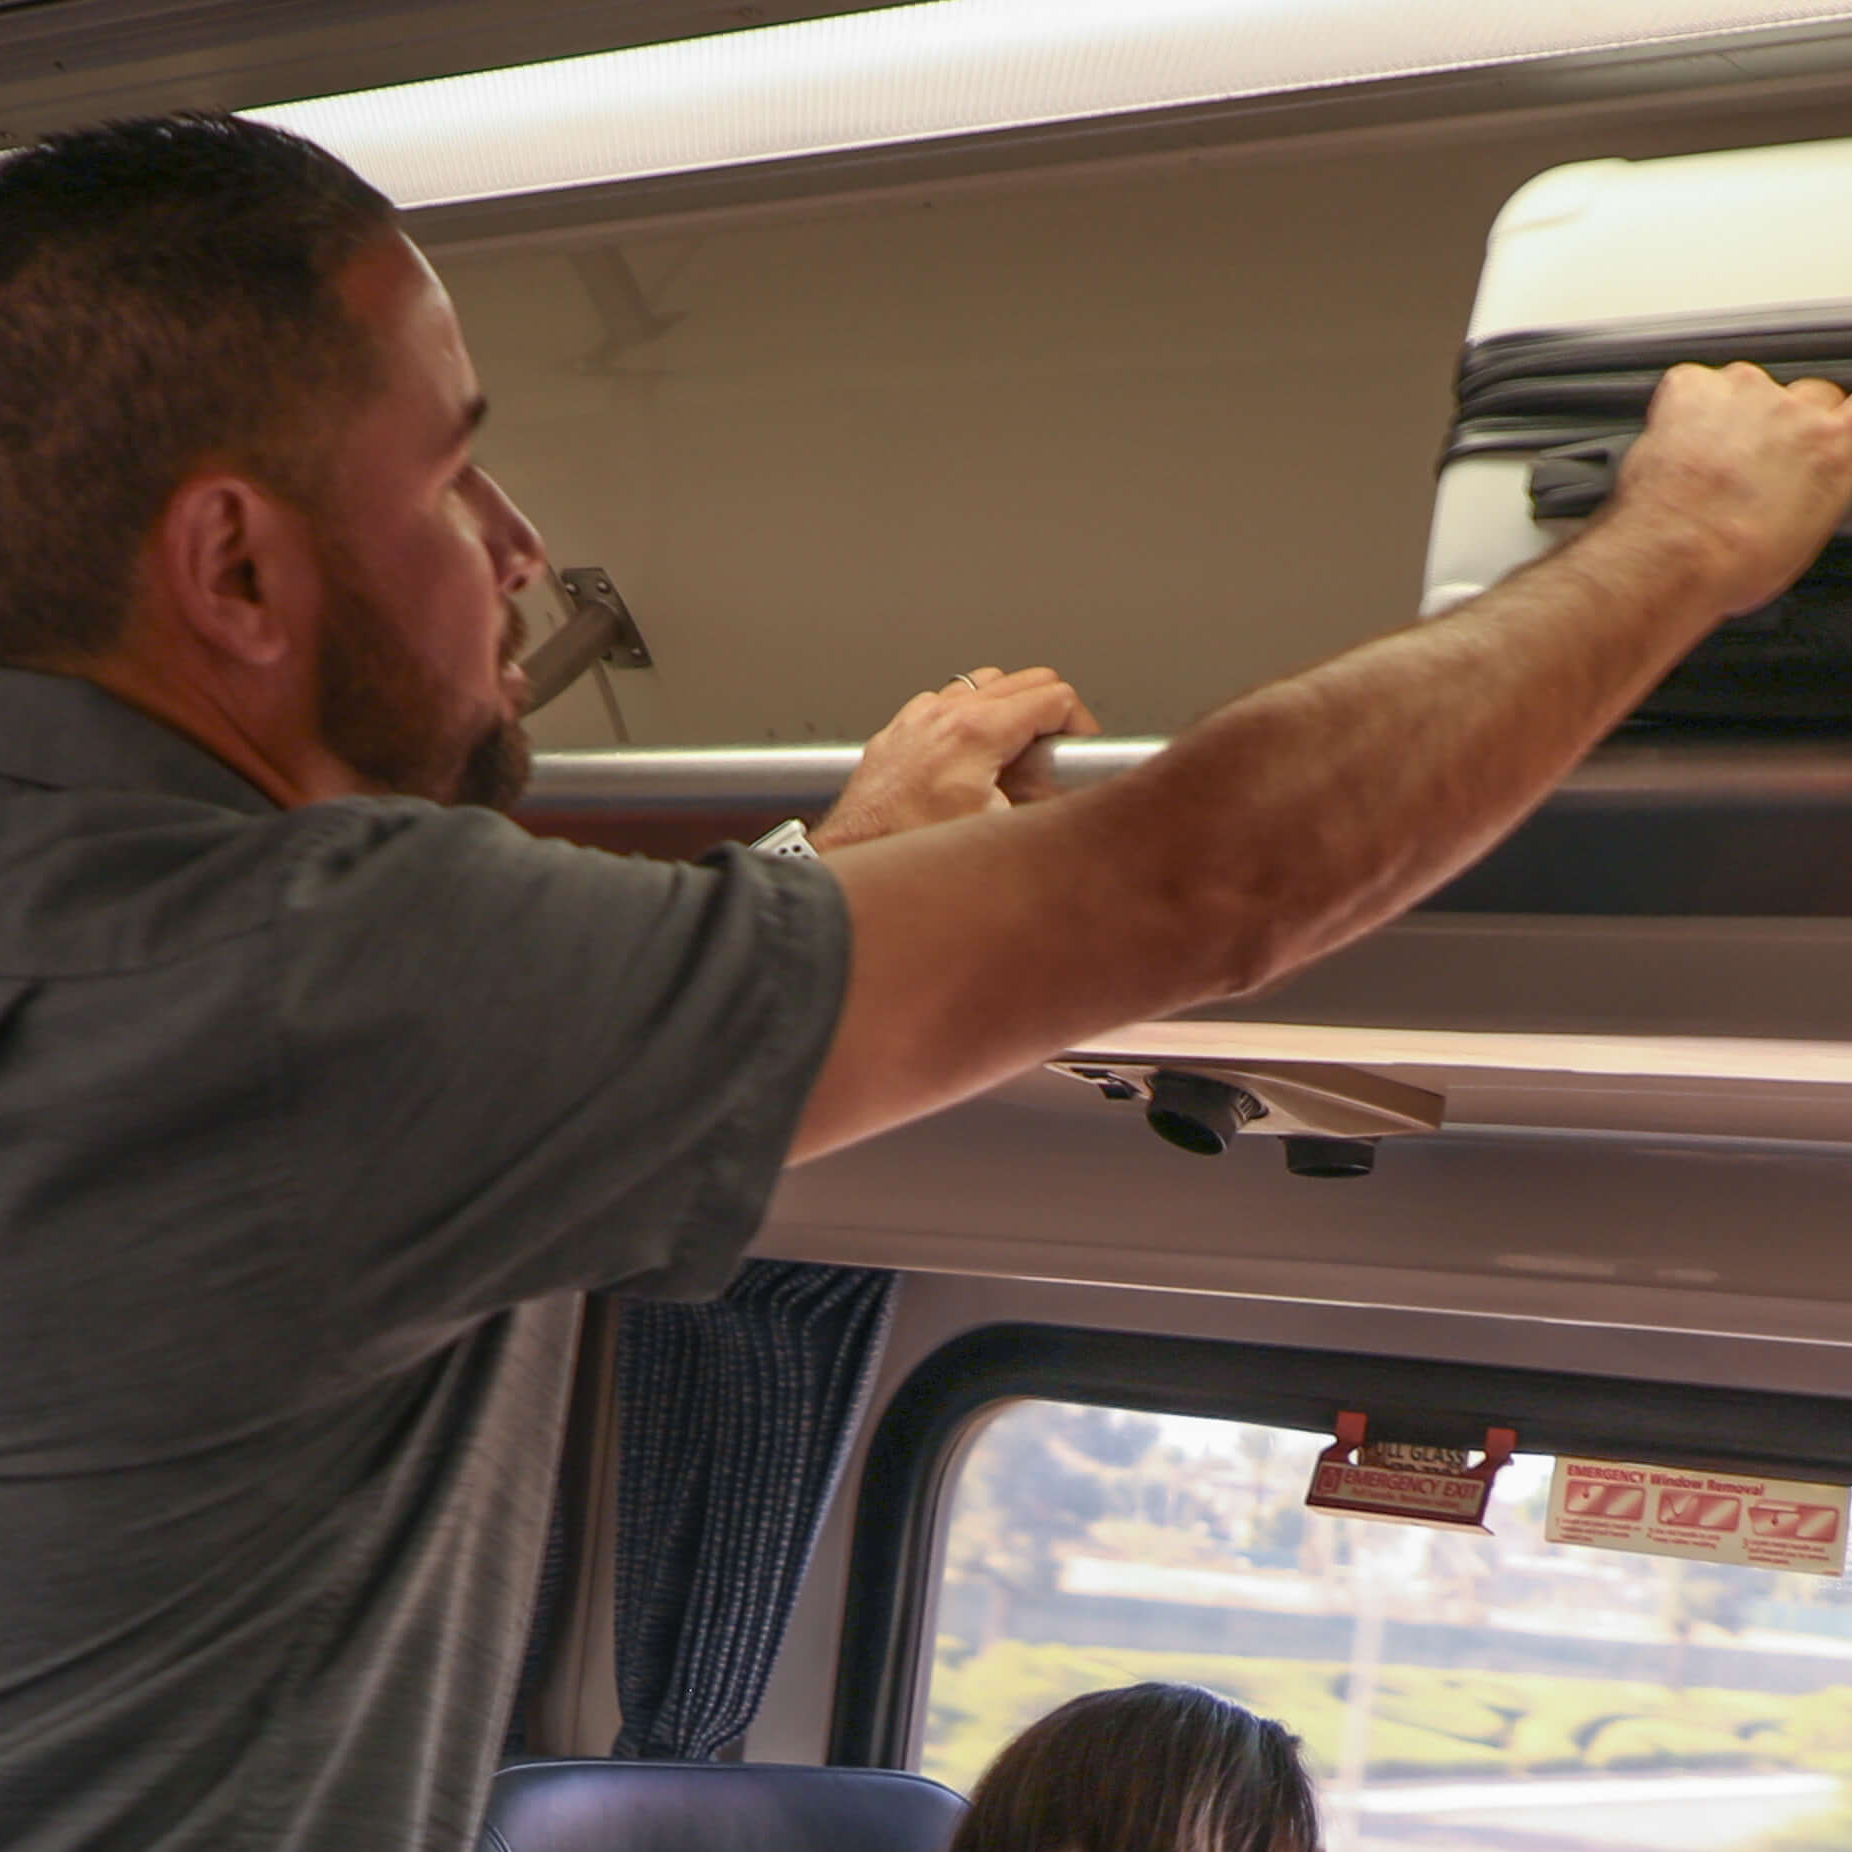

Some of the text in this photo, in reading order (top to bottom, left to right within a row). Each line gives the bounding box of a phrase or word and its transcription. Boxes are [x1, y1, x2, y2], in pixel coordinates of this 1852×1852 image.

[1411, 1446, 1465, 1464] GLASS
[1344, 1469, 1482, 1499] EMERGENCY EXIT
[1567, 1464, 1765, 1497] EMERGENCY Window Removal
